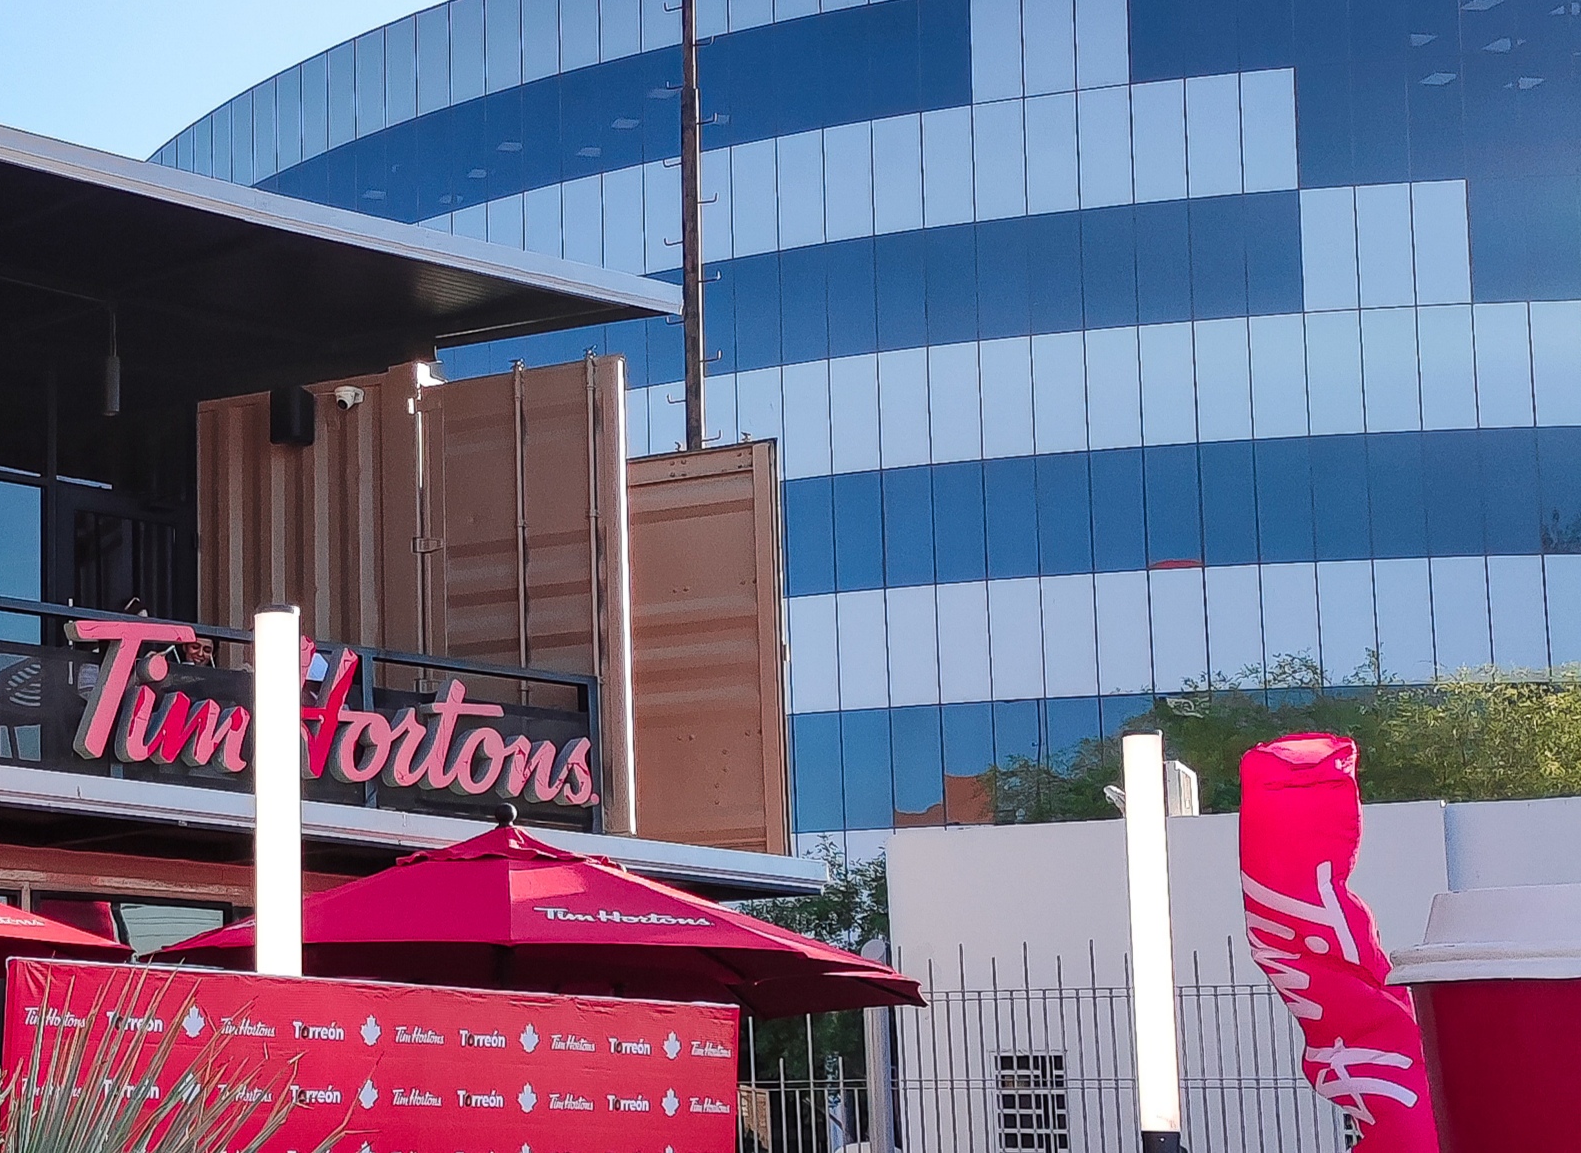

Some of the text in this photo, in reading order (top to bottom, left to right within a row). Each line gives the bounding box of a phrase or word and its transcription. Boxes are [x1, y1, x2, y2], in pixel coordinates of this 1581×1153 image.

[67, 619, 250, 773] Tim
[533, 907, 595, 922] Tim
[45, 1007, 86, 1028] Hotons
[292, 1021, 345, 1041] Torreón
[459, 1030, 506, 1048] Torreón
[608, 1038, 651, 1055] Torreón
[456, 1090, 504, 1108] Torreón
[606, 1095, 650, 1112] Torreón
